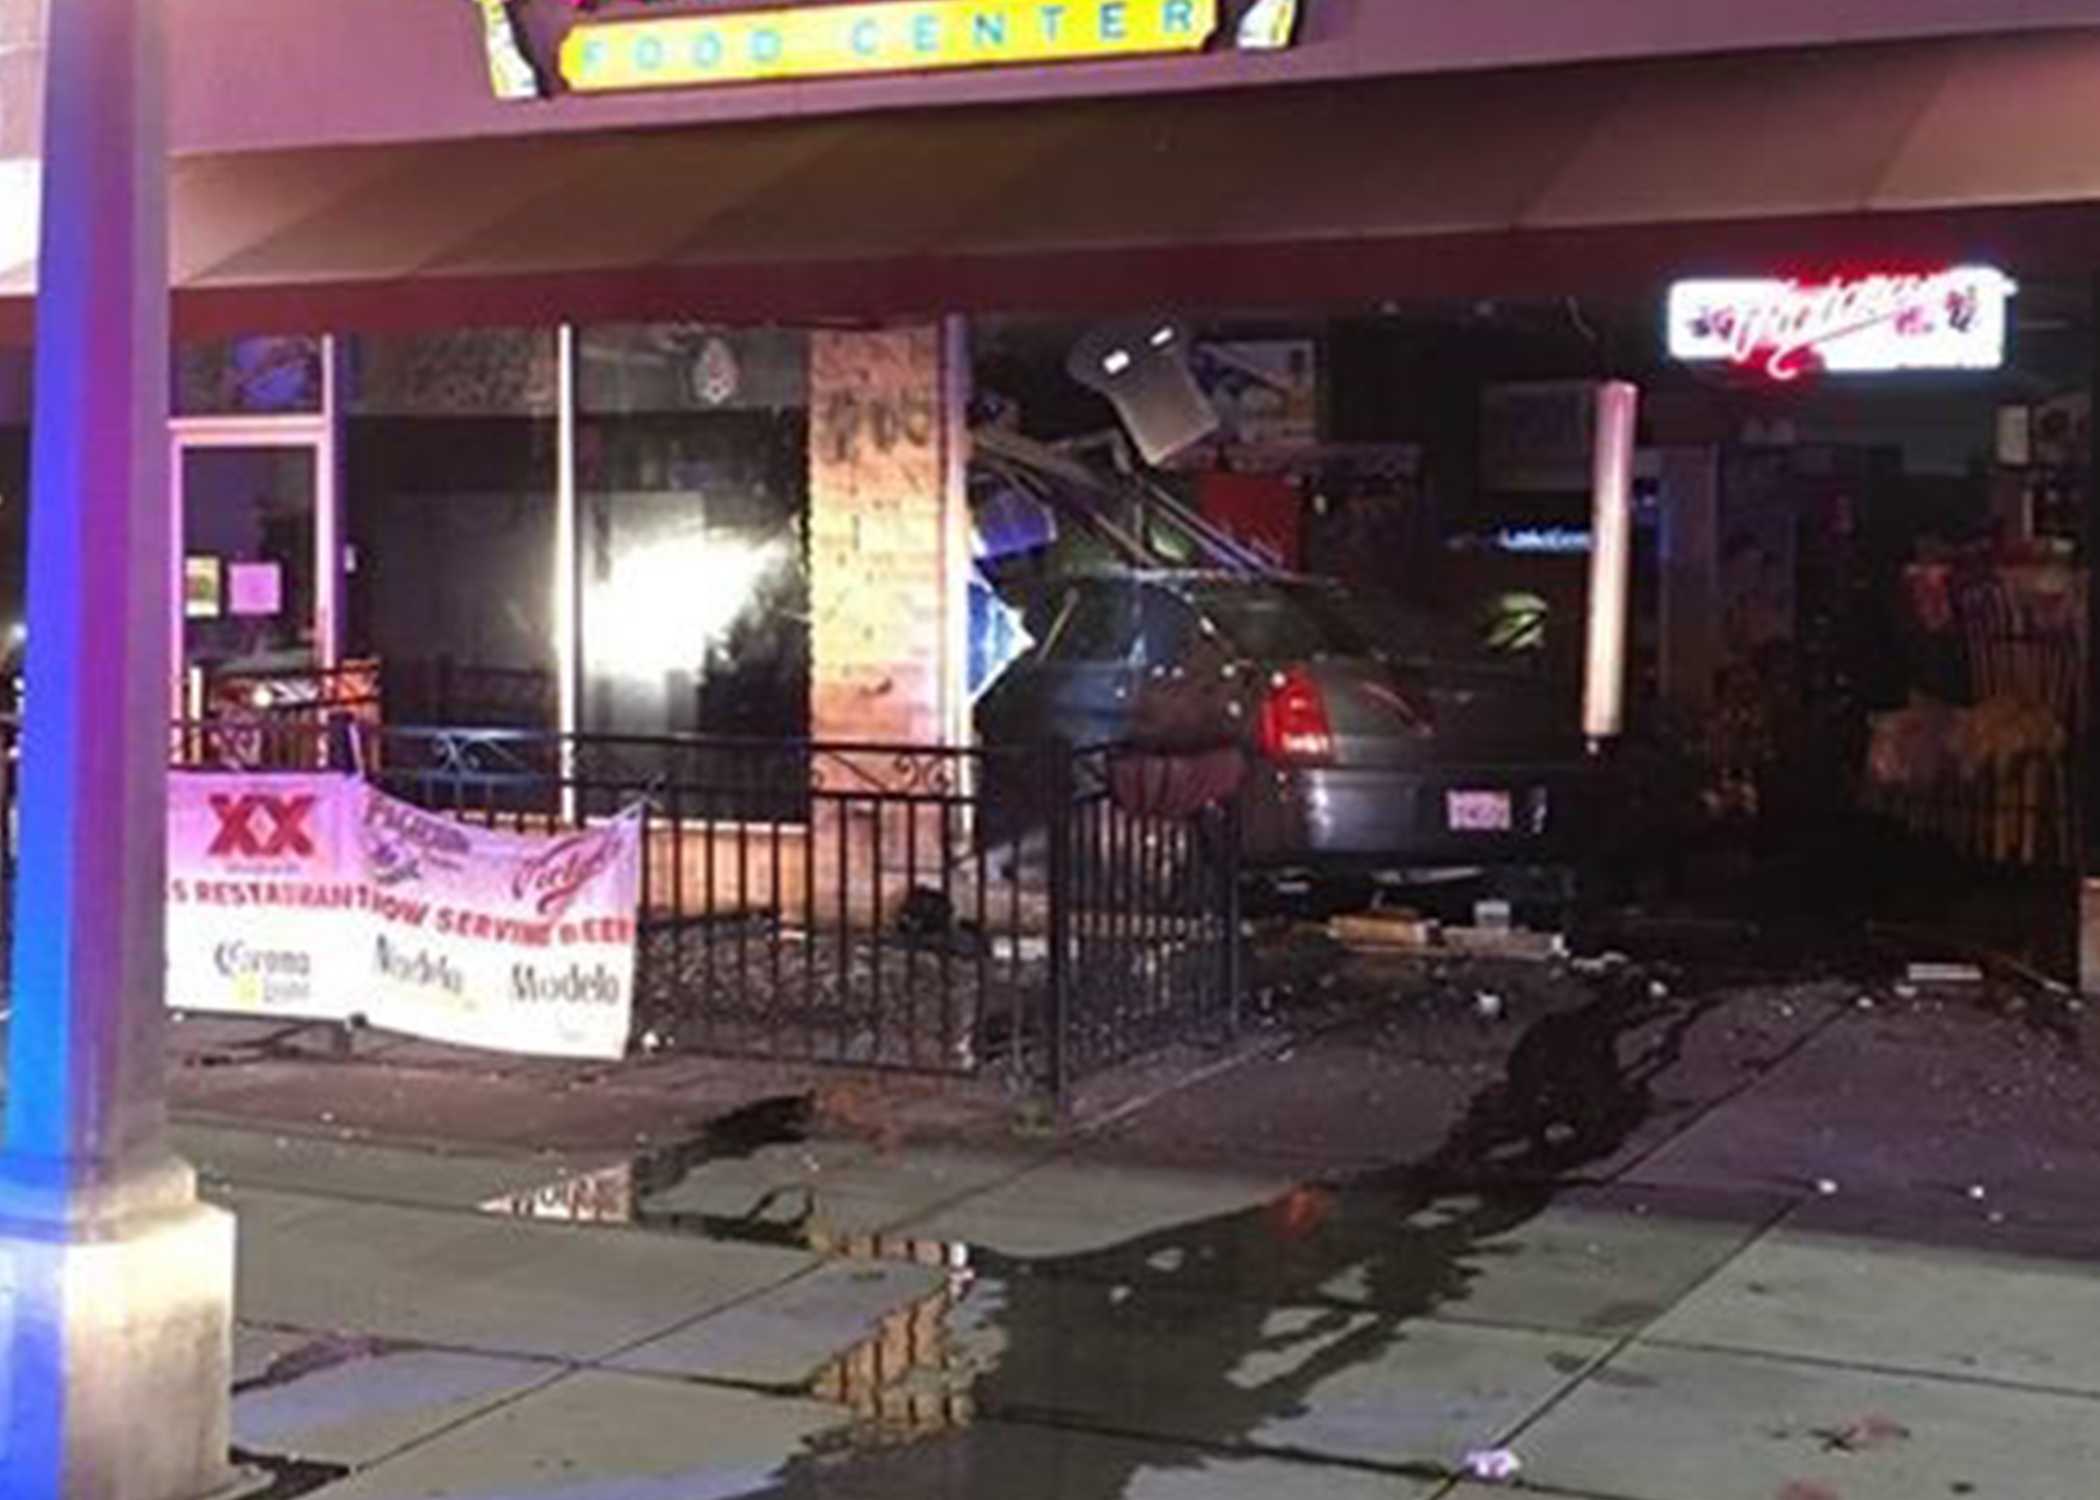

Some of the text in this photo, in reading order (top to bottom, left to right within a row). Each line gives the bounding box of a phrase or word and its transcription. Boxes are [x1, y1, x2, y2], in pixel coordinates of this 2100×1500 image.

[582, 0, 1193, 71] FOOD CENTER
[207, 794, 316, 858] XX
[435, 906, 550, 947] SERVI
[511, 962, 619, 1005] Modelo
